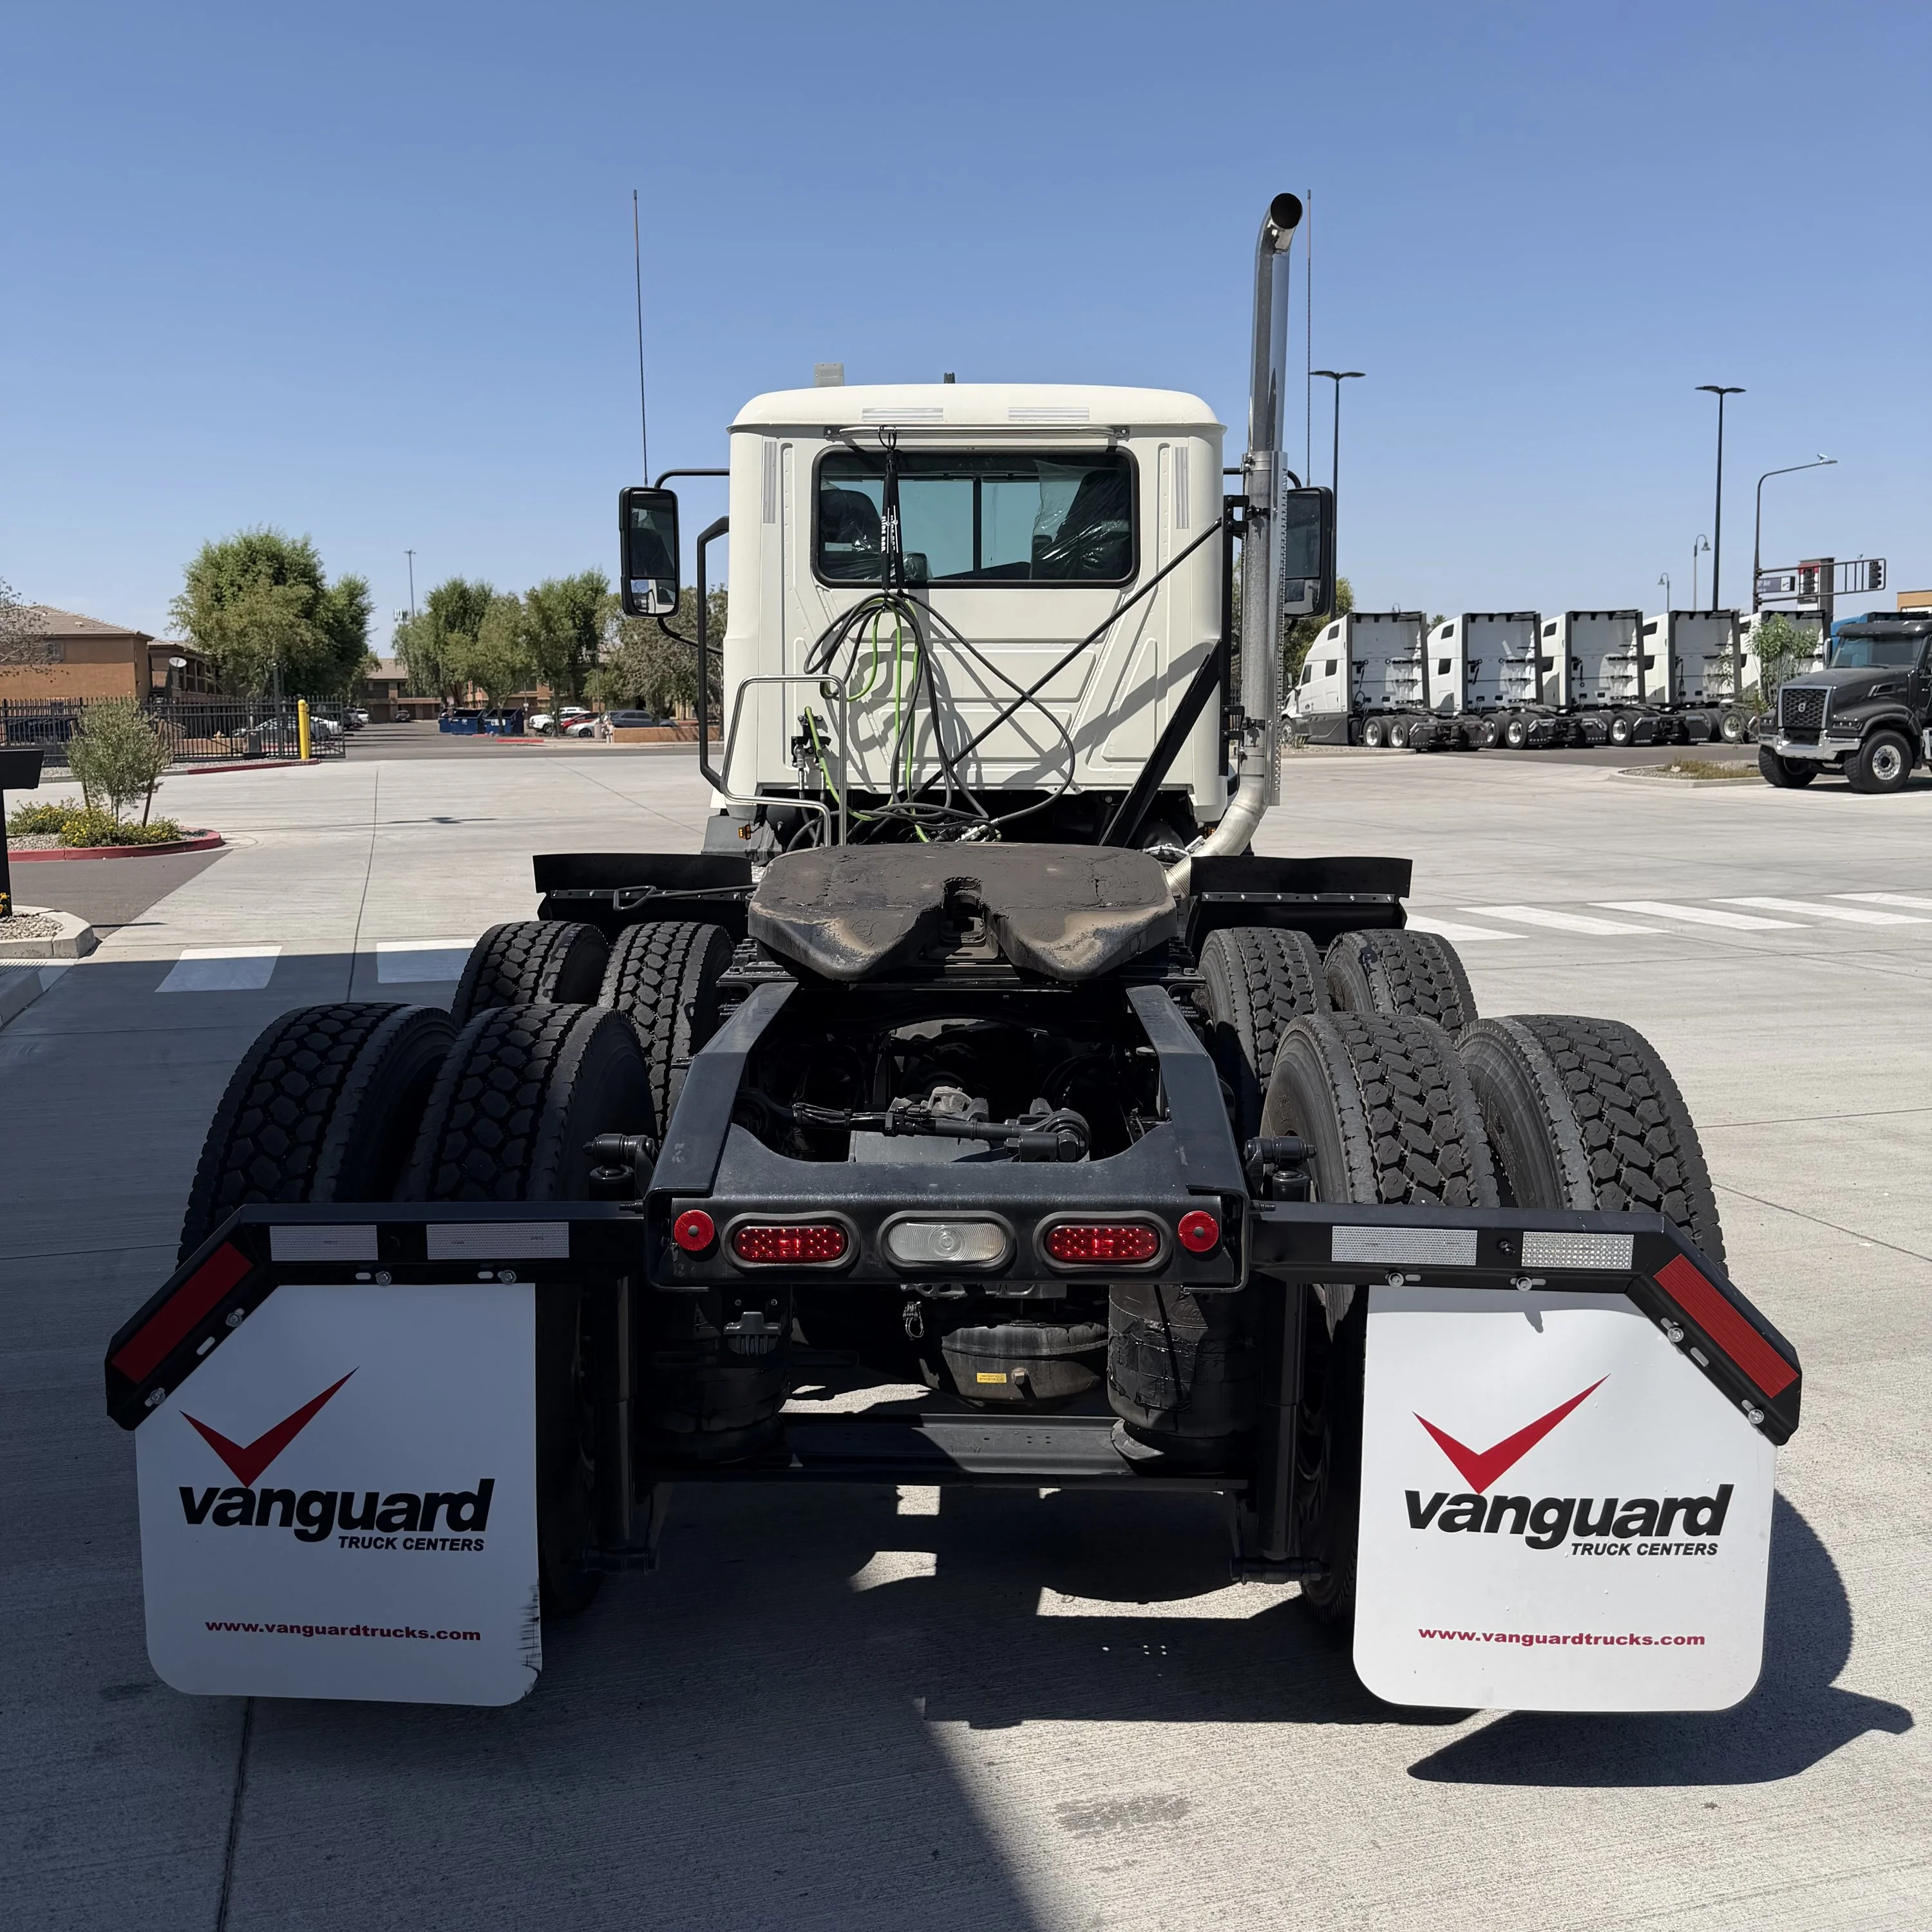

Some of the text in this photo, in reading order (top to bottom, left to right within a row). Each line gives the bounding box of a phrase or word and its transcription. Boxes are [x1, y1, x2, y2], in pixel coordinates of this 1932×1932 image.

[178, 1479, 495, 1542] vanguard
[1405, 1484, 1734, 1550] vanguard
[338, 1535, 485, 1551] TRUCK CENTERS
[1571, 1542, 1718, 1556] TRUCK CENTERS
[205, 1622, 481, 1641] www.vanguardtrucks.com
[1418, 1629, 1705, 1647] www.vanguardtrucks.com
